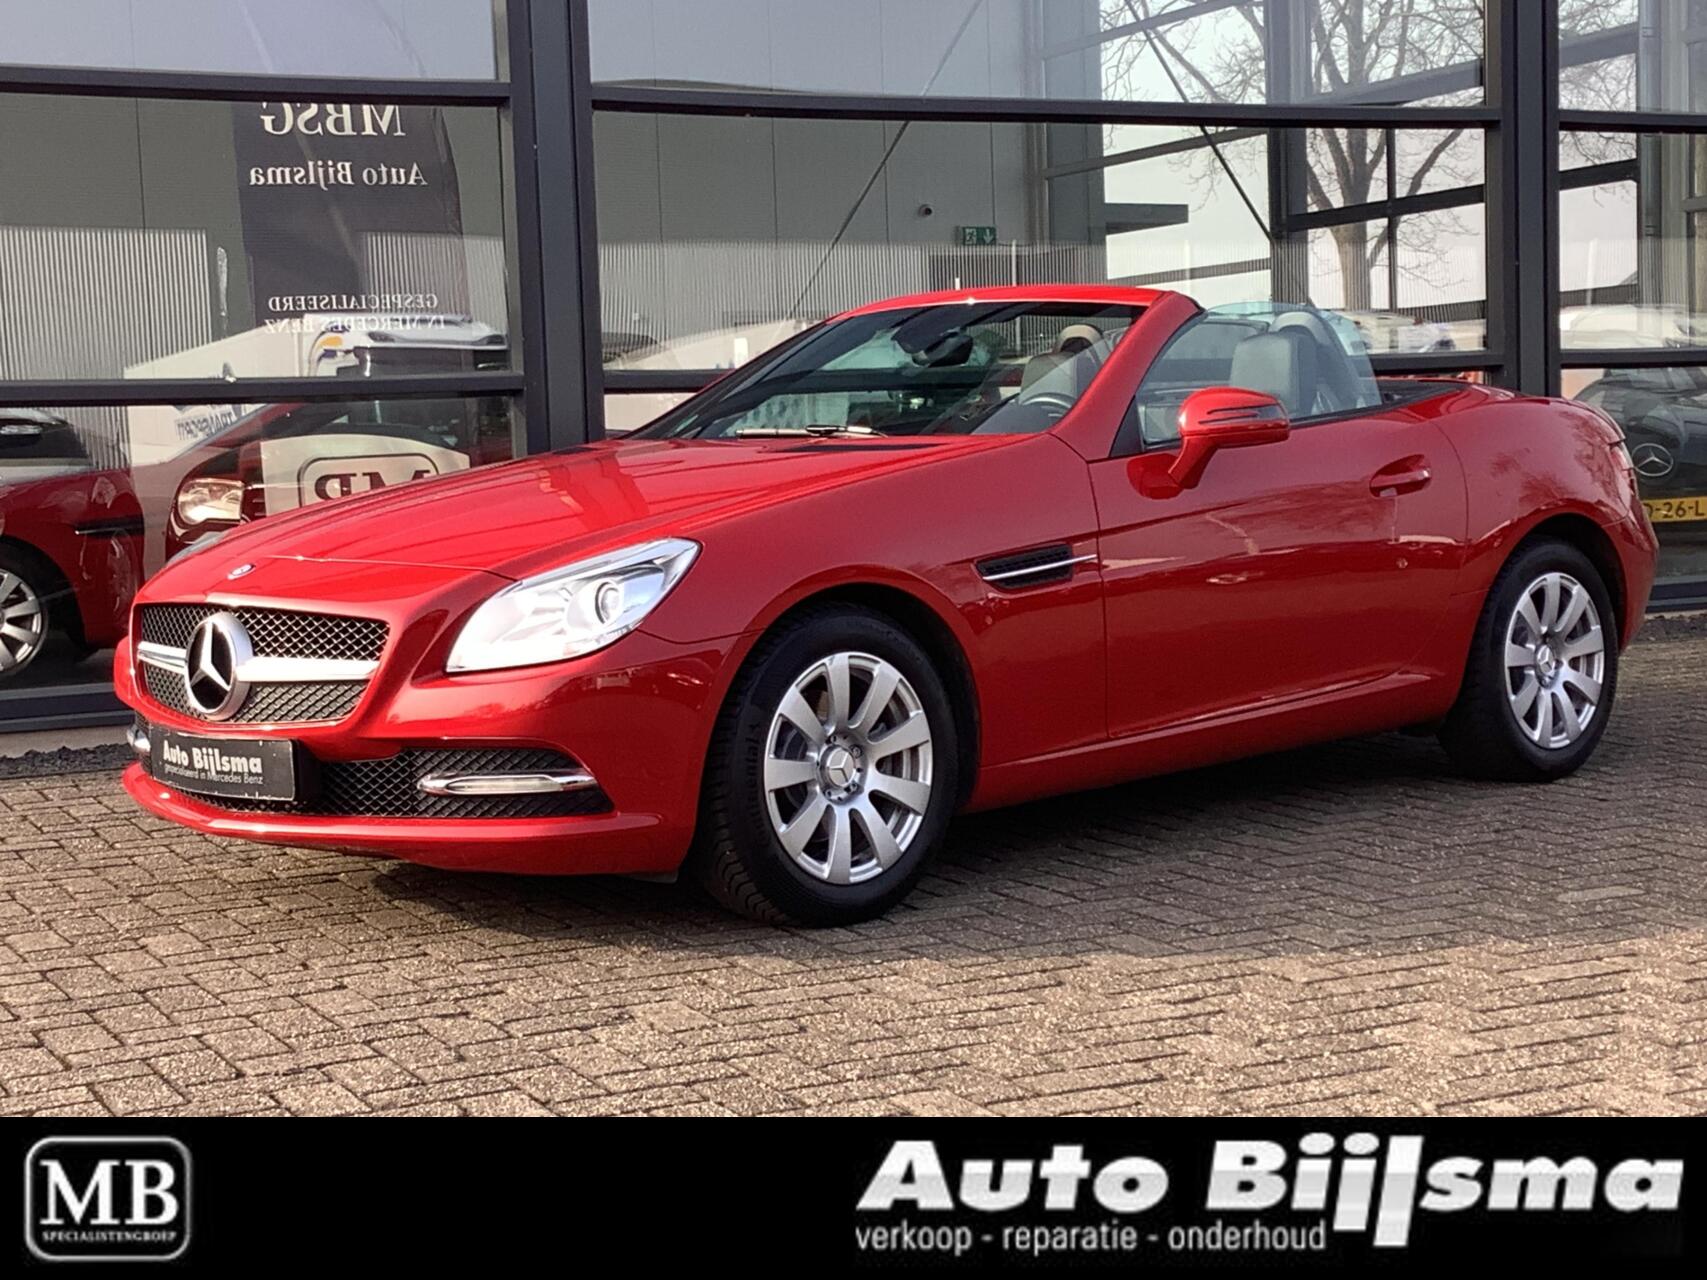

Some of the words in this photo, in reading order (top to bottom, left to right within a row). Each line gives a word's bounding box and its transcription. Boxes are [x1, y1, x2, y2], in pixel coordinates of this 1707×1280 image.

[163, 740, 189, 767] Auto
[192, 747, 262, 775] Bijlsma
[243, 772, 264, 785] Benz
